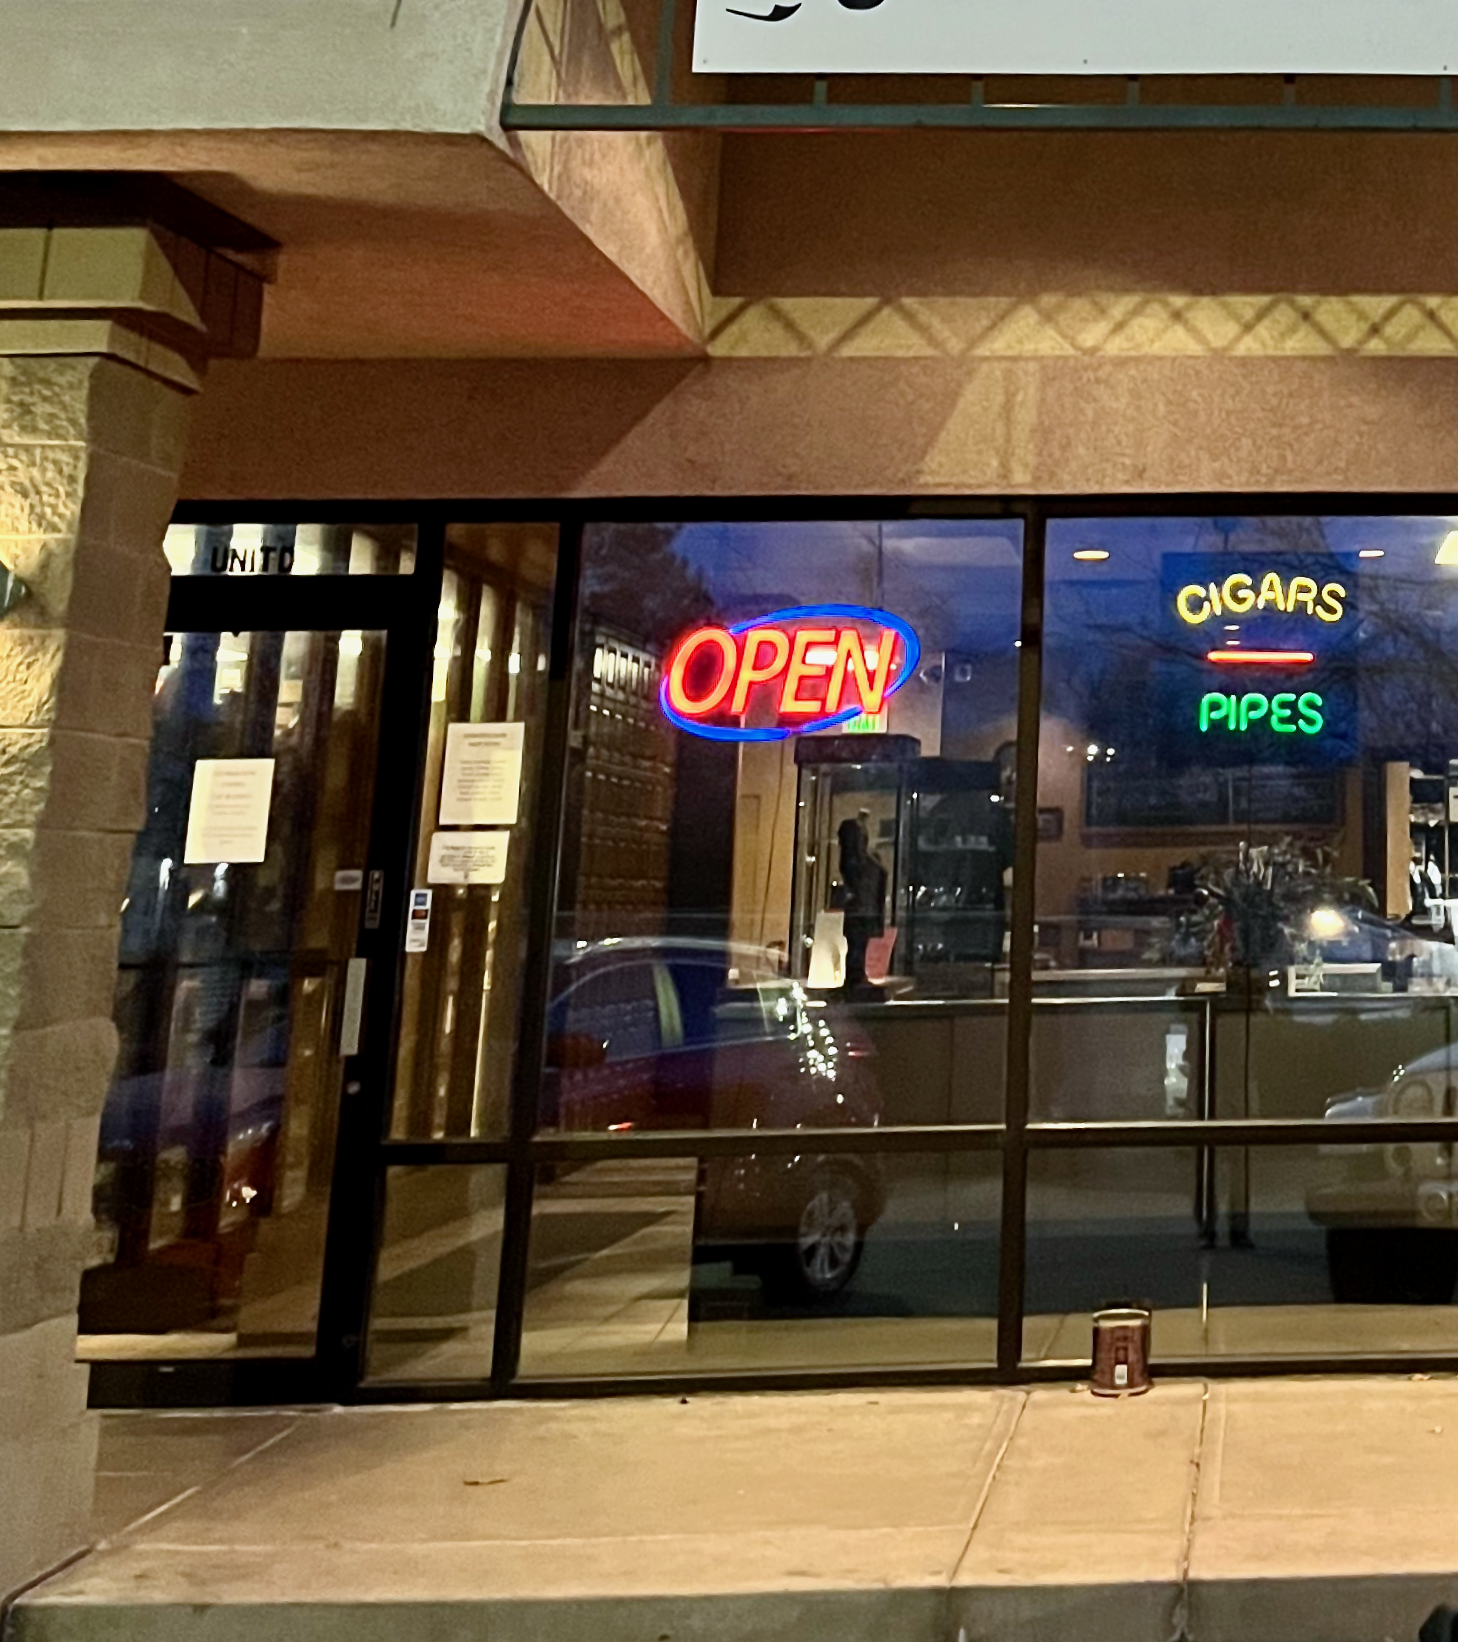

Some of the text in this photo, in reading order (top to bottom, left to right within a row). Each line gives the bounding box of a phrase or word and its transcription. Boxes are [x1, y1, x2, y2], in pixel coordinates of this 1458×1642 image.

[1176, 571, 1347, 624] CIGARS
[669, 627, 897, 715] OPEN
[1199, 691, 1324, 735] PIPES
